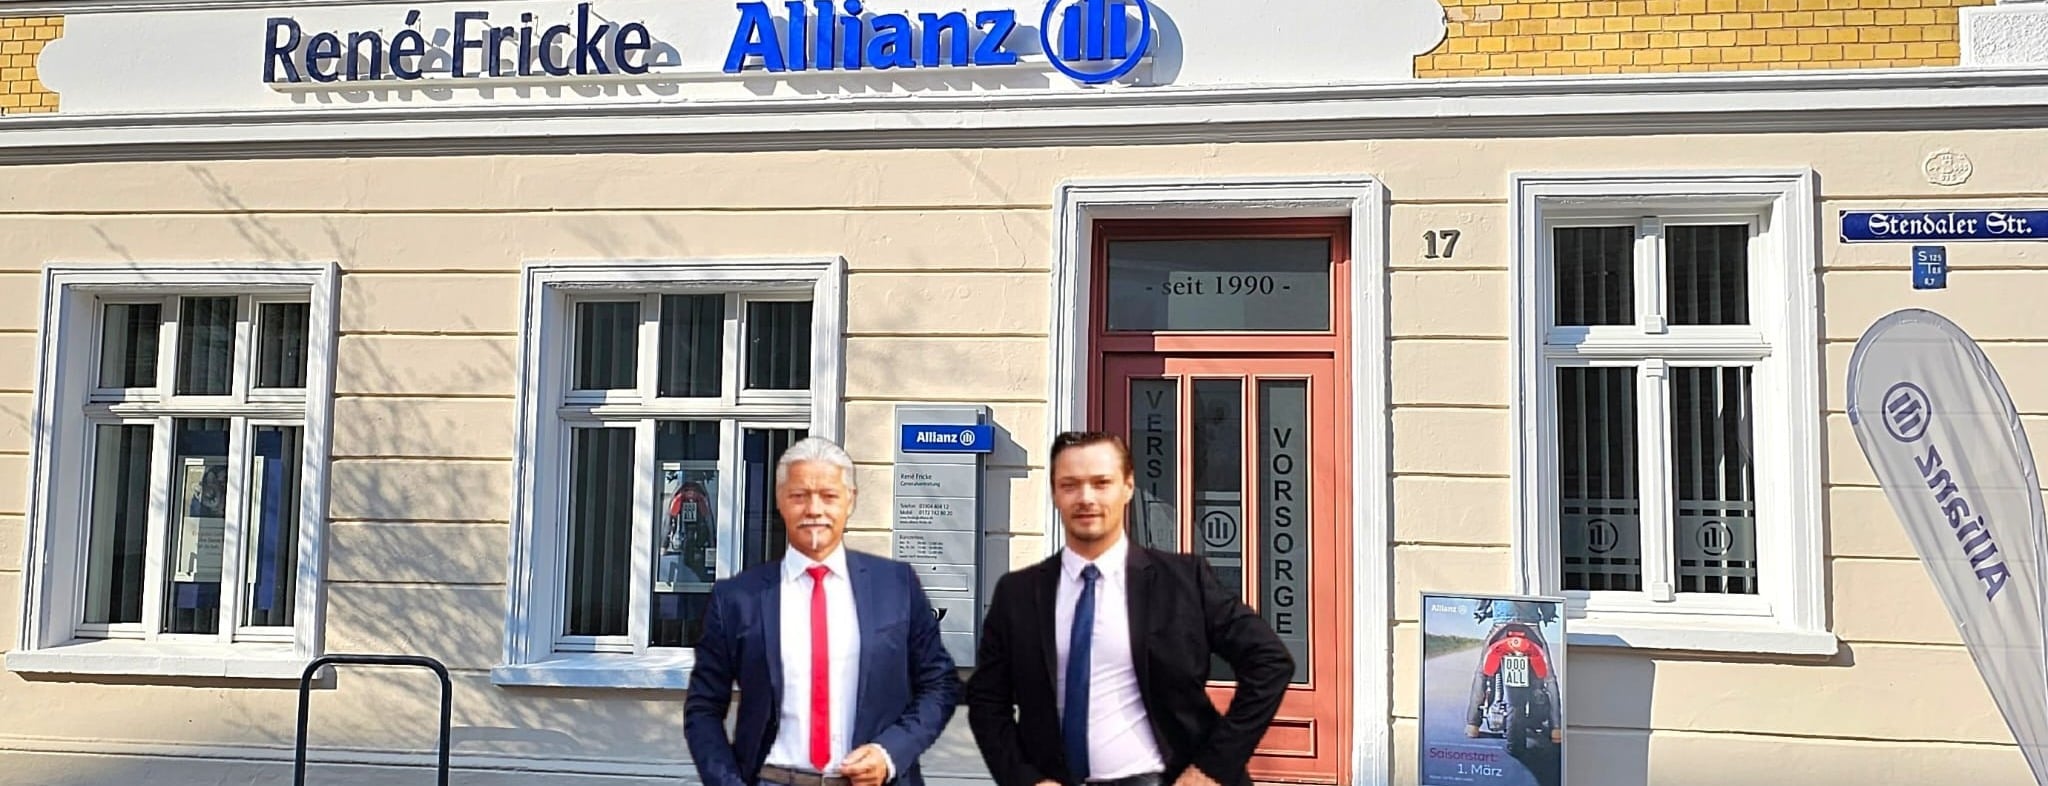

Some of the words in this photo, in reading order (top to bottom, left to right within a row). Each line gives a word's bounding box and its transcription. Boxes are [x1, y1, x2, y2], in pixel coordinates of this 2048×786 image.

[263, 9, 425, 84] René
[452, 2, 651, 78] Fricke
[723, 0, 1017, 74] Allianz
[1868, 212, 1978, 235] Stendaler
[1985, 212, 2033, 235] Str.
[1422, 229, 1461, 259] 17
[1161, 276, 1203, 296] seit
[1214, 276, 1275, 296] 1990
[916, 431, 958, 443] Allianz
[1272, 427, 1294, 635] VORSORGE
[1431, 604, 1457, 613] Allianz
[1506, 671, 1526, 684] ALL
[1429, 747, 1499, 763] Saisonstart:
[1457, 763, 1468, 775] 1.
[1471, 764, 1503, 777] März
